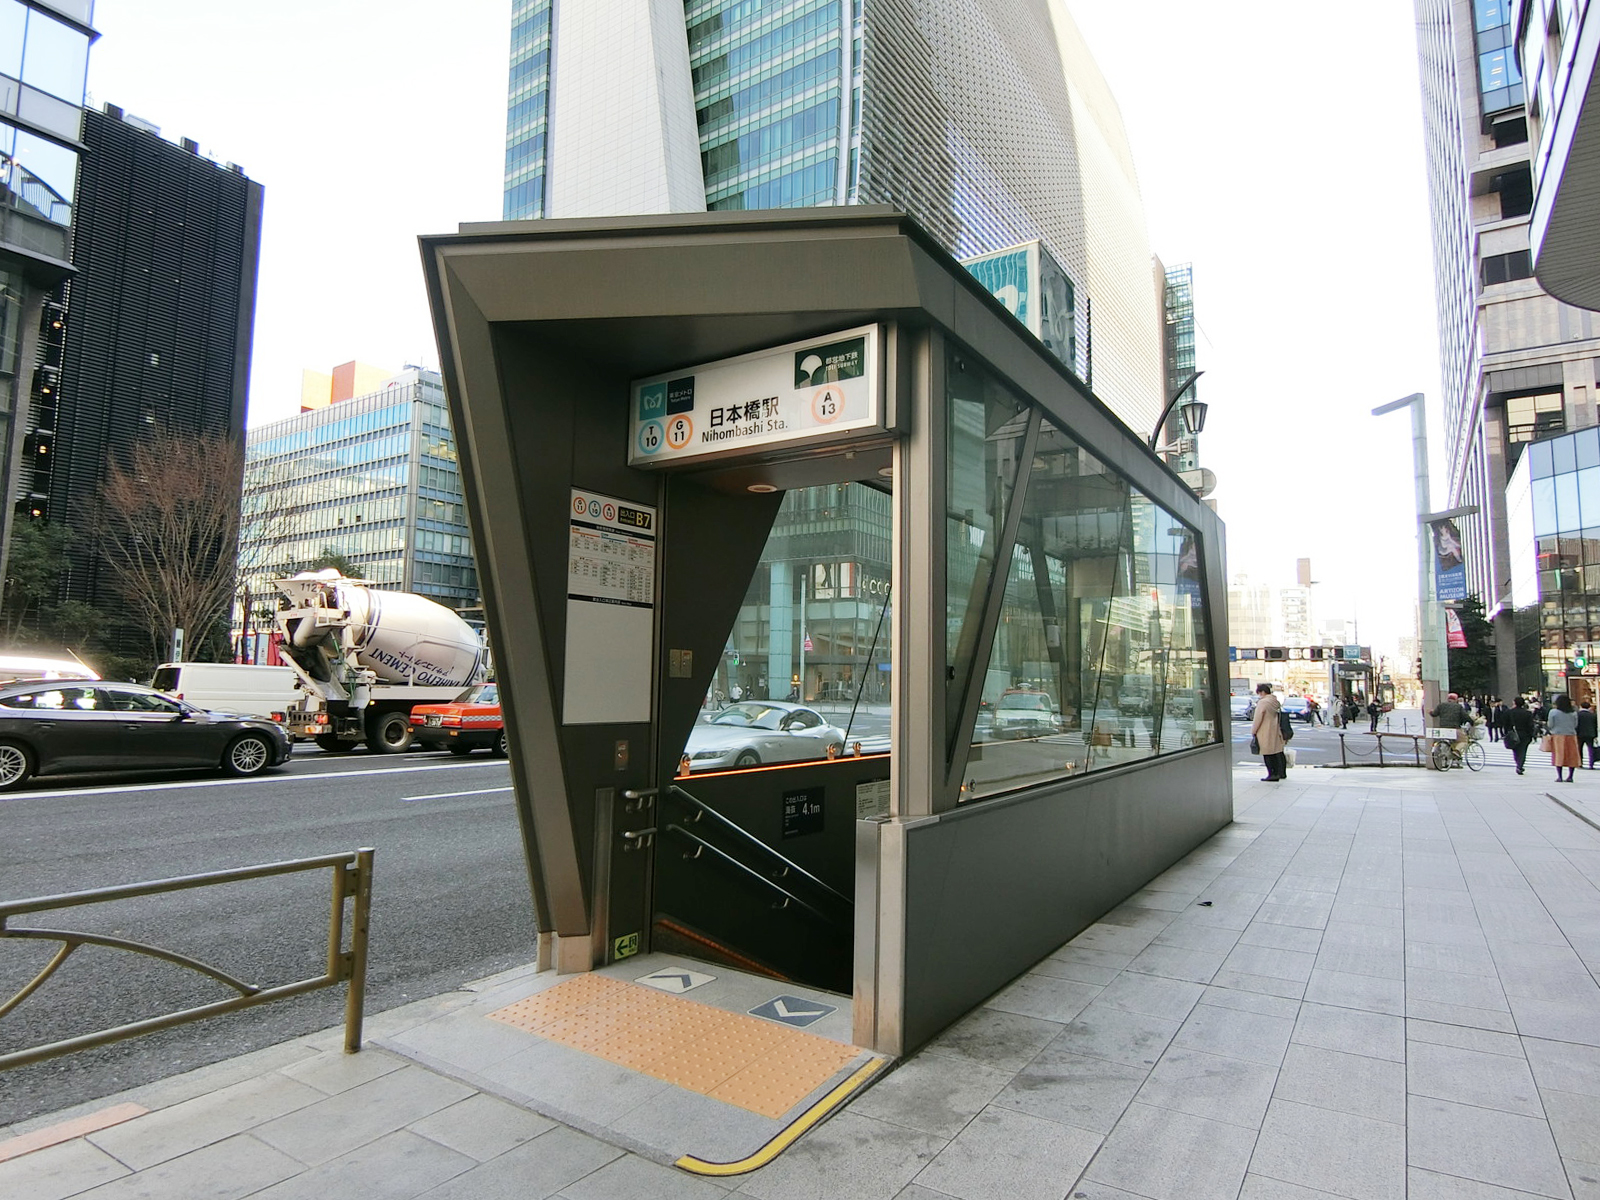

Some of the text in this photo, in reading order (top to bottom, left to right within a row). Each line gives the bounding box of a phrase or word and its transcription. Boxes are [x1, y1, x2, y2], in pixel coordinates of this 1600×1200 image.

[837, 360, 858, 369] SUBWAY
[823, 391, 833, 403] A
[710, 396, 779, 427] 日本橋駅
[821, 403, 836, 416] 13
[649, 425, 655, 435] T
[676, 420, 684, 430] G
[674, 431, 684, 442] 11
[702, 419, 788, 443] Nihombashi Sta.
[646, 436, 658, 447] 10
[636, 512, 651, 527] B7
[300, 582, 317, 593] 112
[802, 803, 820, 816] 4.1m
